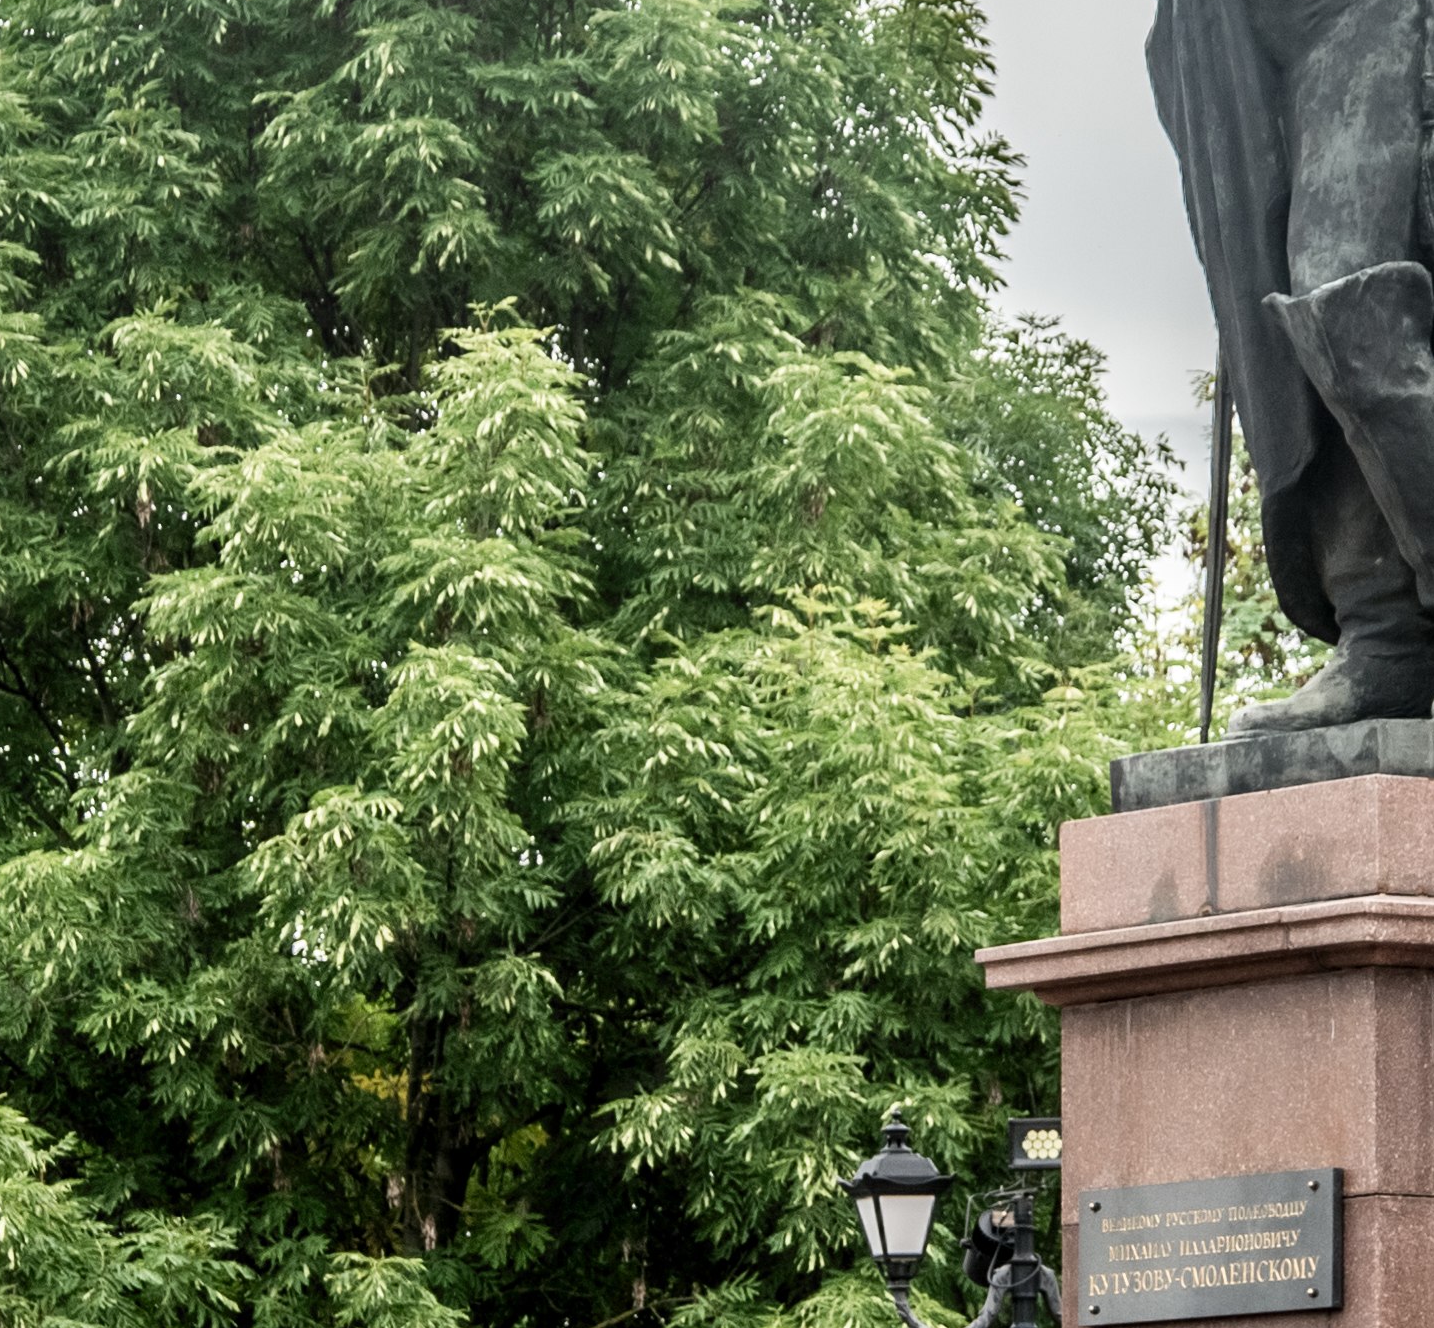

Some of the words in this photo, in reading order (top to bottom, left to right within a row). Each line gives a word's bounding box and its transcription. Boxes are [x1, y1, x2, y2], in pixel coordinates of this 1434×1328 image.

[1166, 1207, 1224, 1227] РУССКОМУ
[1228, 1200, 1308, 1222] ПОЛКОВОДЦУ
[1109, 1240, 1174, 1262] МИХАИЛУ
[1180, 1229, 1301, 1256] ИЛЛАРИОНОВИЧУ
[1089, 1255, 1320, 1297] КУТУЗОВУ-СМОЛЕНСКОМУ
